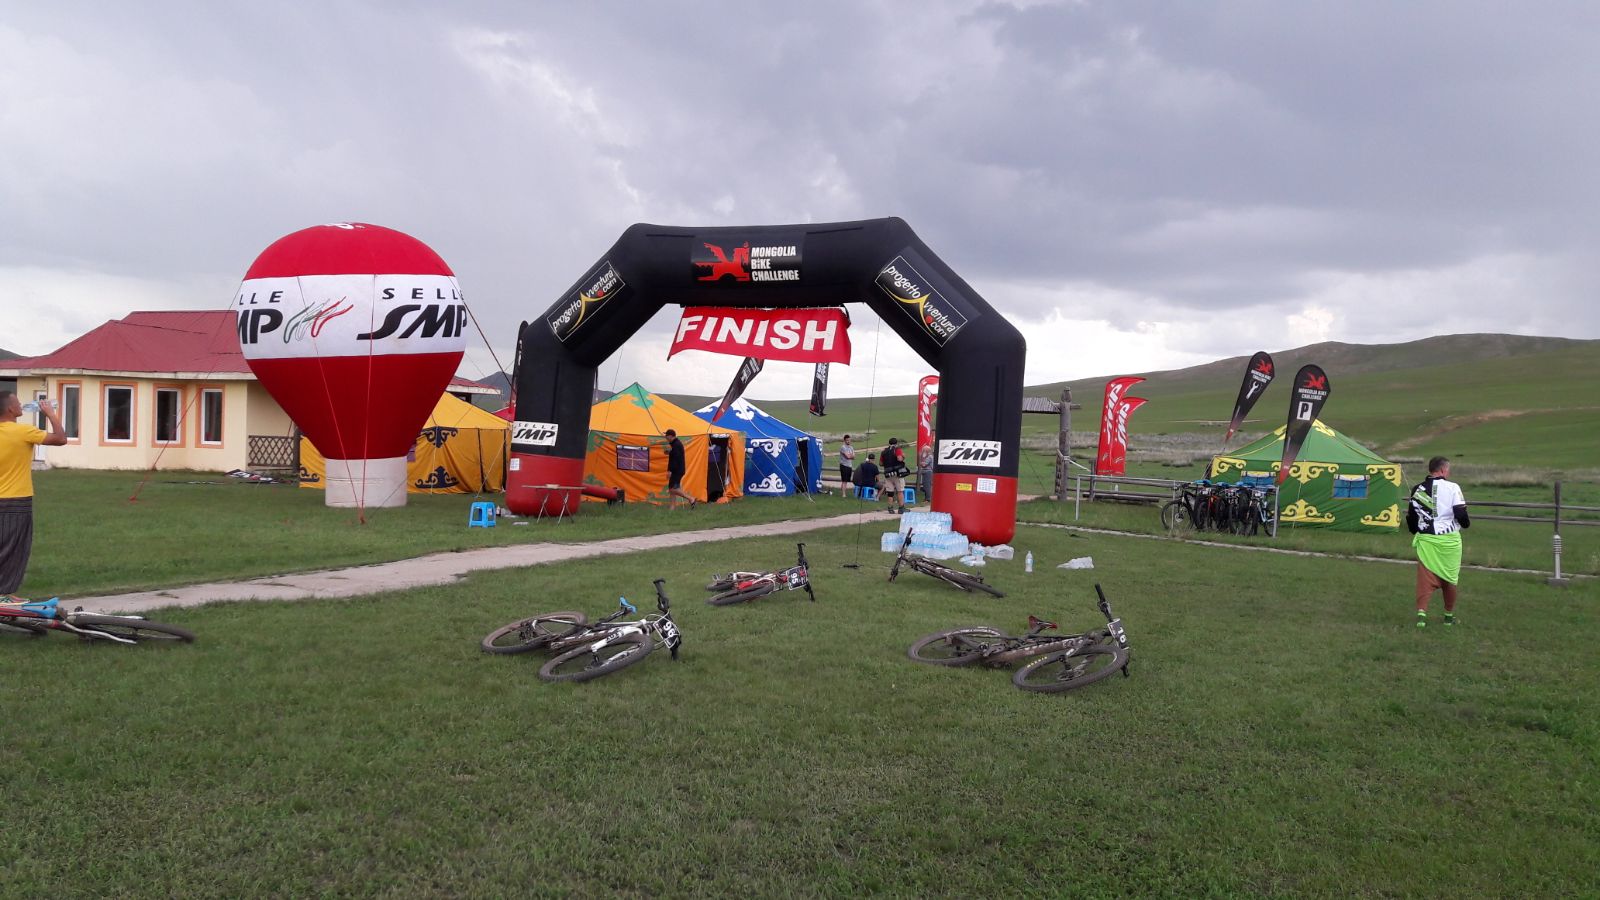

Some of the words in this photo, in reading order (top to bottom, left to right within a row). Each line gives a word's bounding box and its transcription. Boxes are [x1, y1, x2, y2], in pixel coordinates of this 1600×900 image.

[751, 246, 796, 257] MONGOLIA
[752, 269, 800, 281] CHALLENGE
[883, 265, 921, 299] progetto
[356, 304, 467, 340] SMP
[552, 299, 582, 331] progetto
[676, 315, 837, 350] FINISH
[1300, 402, 1310, 418] P
[514, 428, 556, 441] SMP
[951, 441, 999, 449] SELLE
[943, 447, 999, 461] SMP
[789, 573, 799, 585] 95
